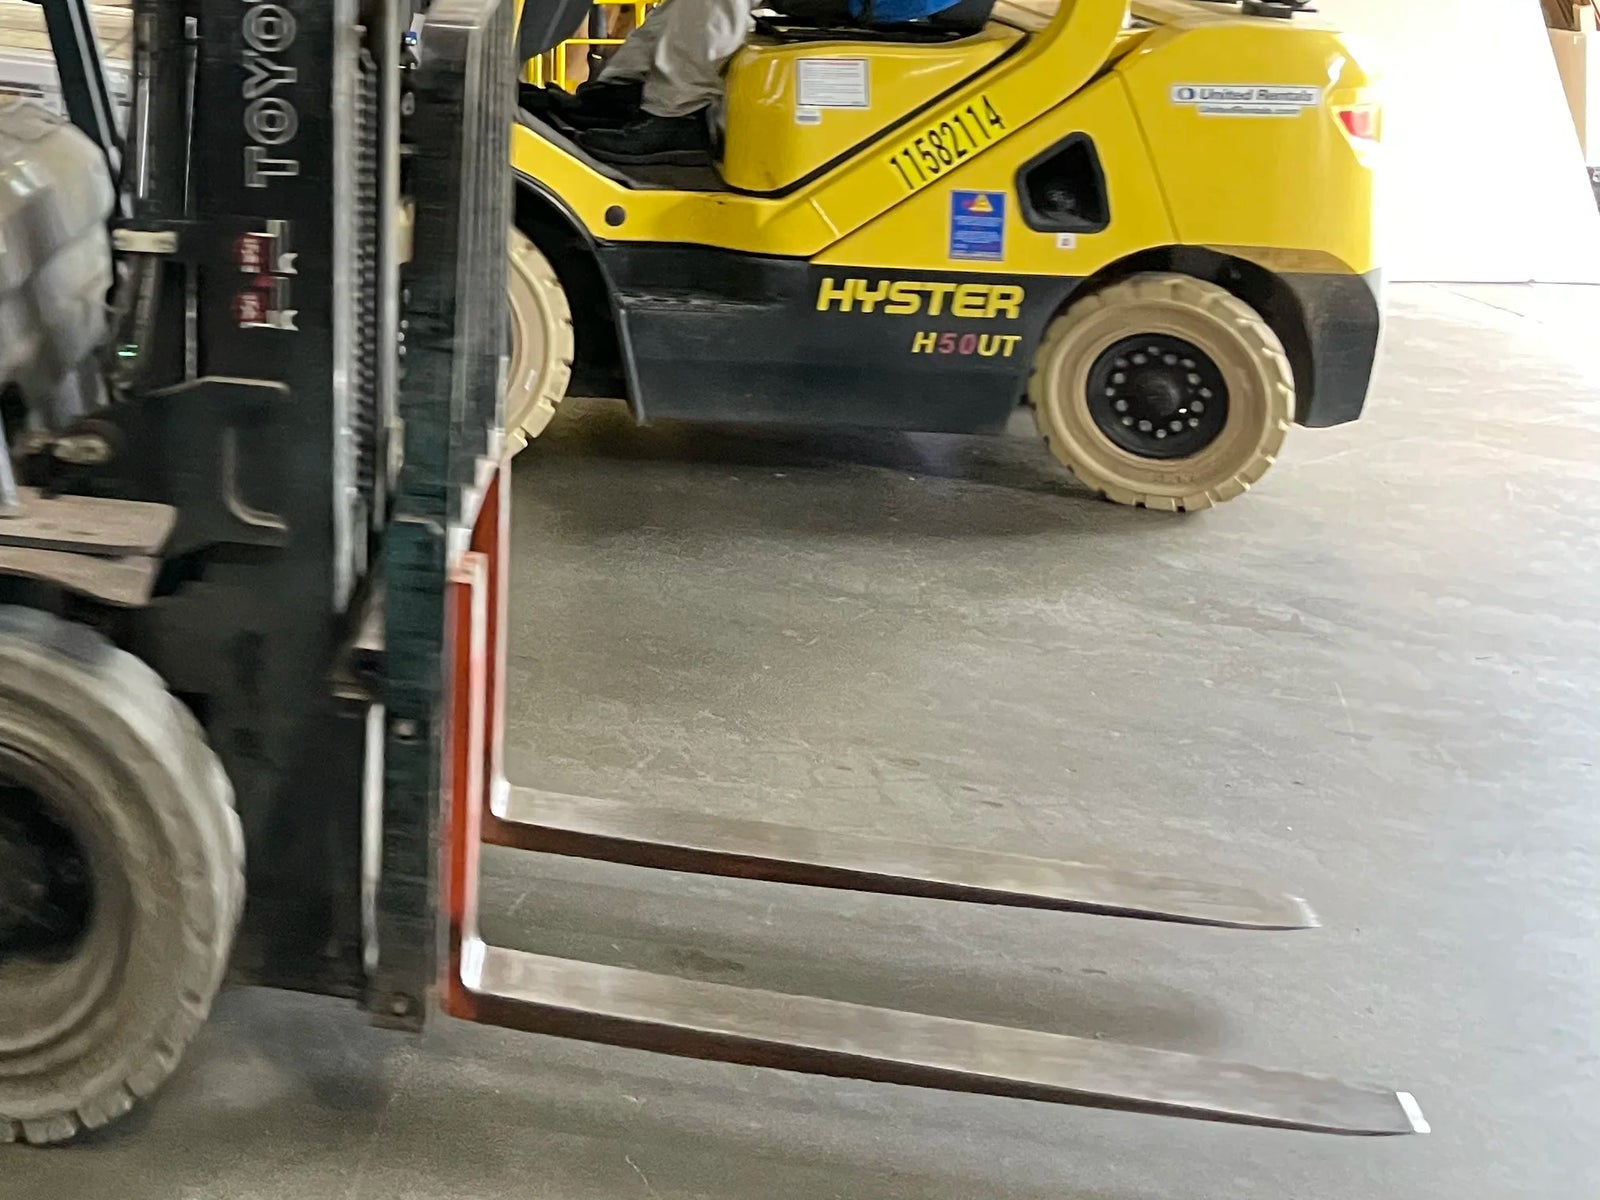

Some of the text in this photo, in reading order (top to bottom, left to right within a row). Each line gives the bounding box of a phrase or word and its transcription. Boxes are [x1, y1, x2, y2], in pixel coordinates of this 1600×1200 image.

[889, 93, 1007, 191] 11582114
[816, 277, 1025, 320] HYSTER
[911, 331, 1023, 358] H50UT
